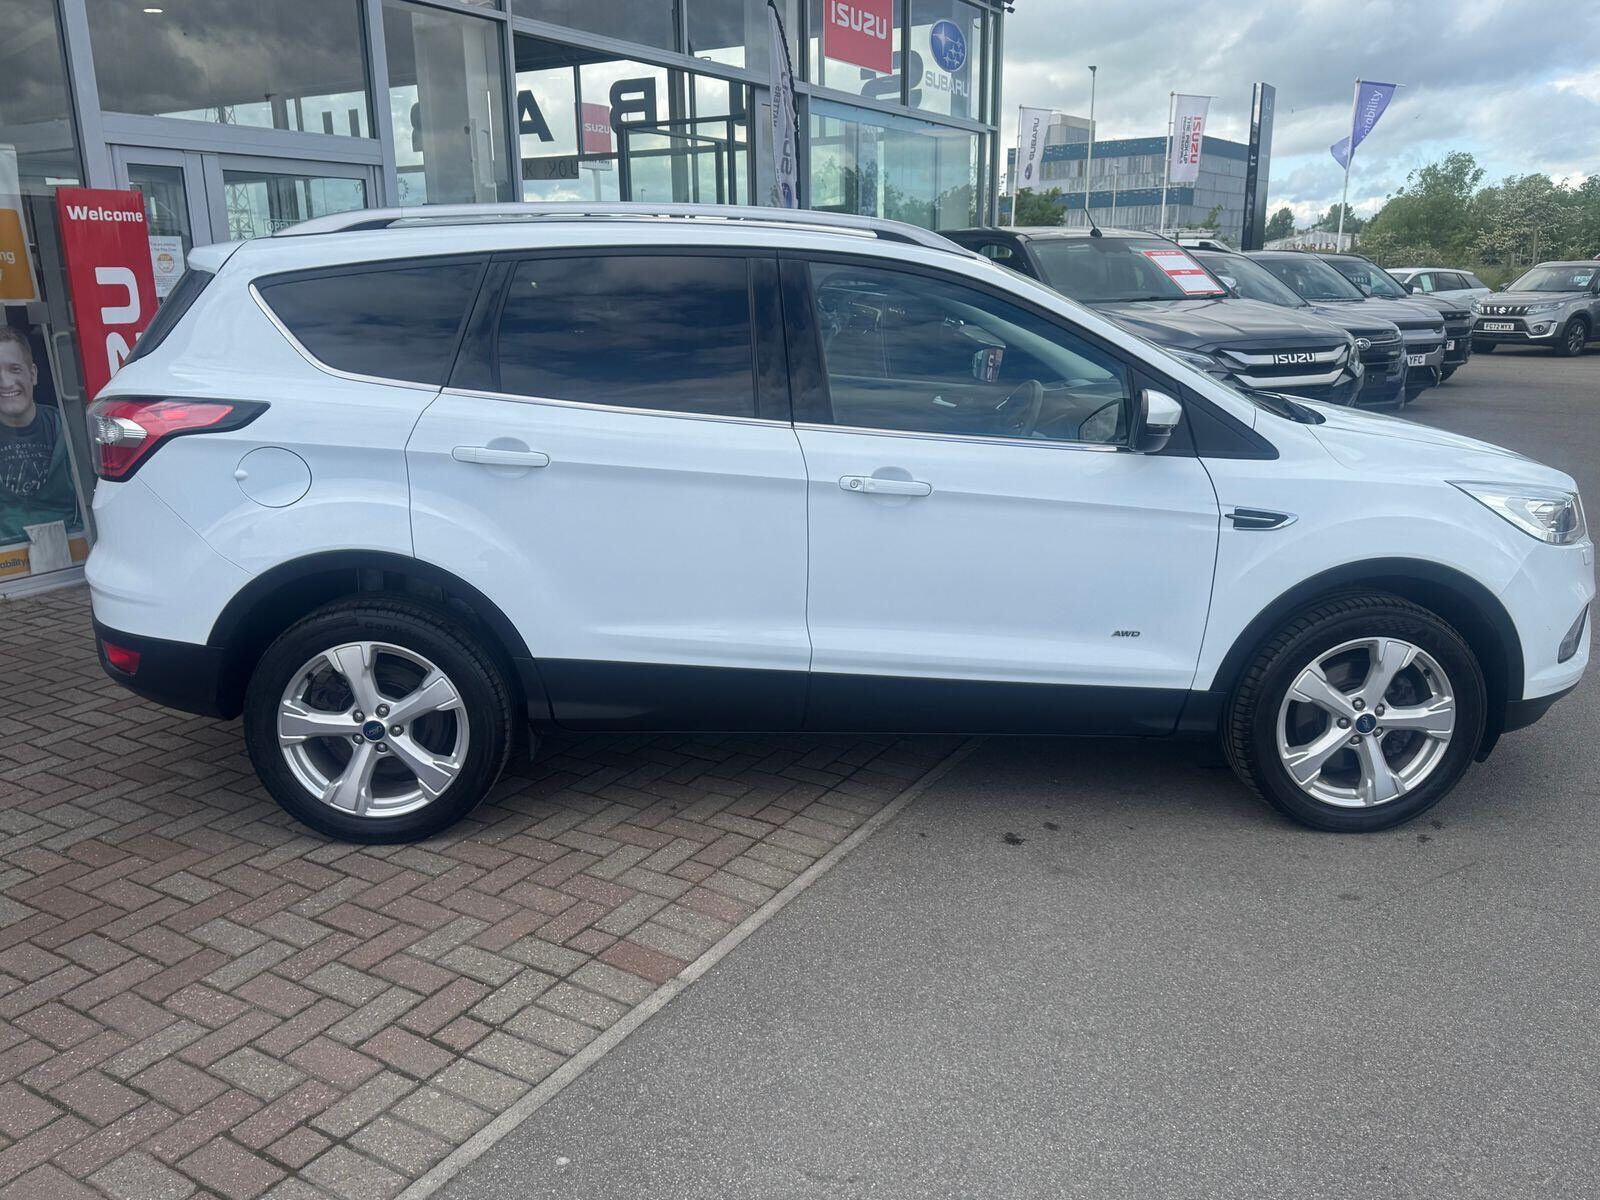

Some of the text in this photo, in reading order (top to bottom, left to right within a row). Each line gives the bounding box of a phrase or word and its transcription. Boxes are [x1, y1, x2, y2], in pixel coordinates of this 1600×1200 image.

[831, 1, 887, 40] ISUZU
[925, 71, 970, 97] SUBARU
[1361, 89, 1383, 138] otability
[585, 122, 610, 135] SUZU
[1029, 117, 1040, 161] SUBARU
[1190, 117, 1201, 163] ISUZU
[66, 205, 143, 223] Welcome
[1274, 352, 1315, 364] ISUZU
[1409, 355, 1423, 365] YFC
[1111, 630, 1141, 638] AWD
